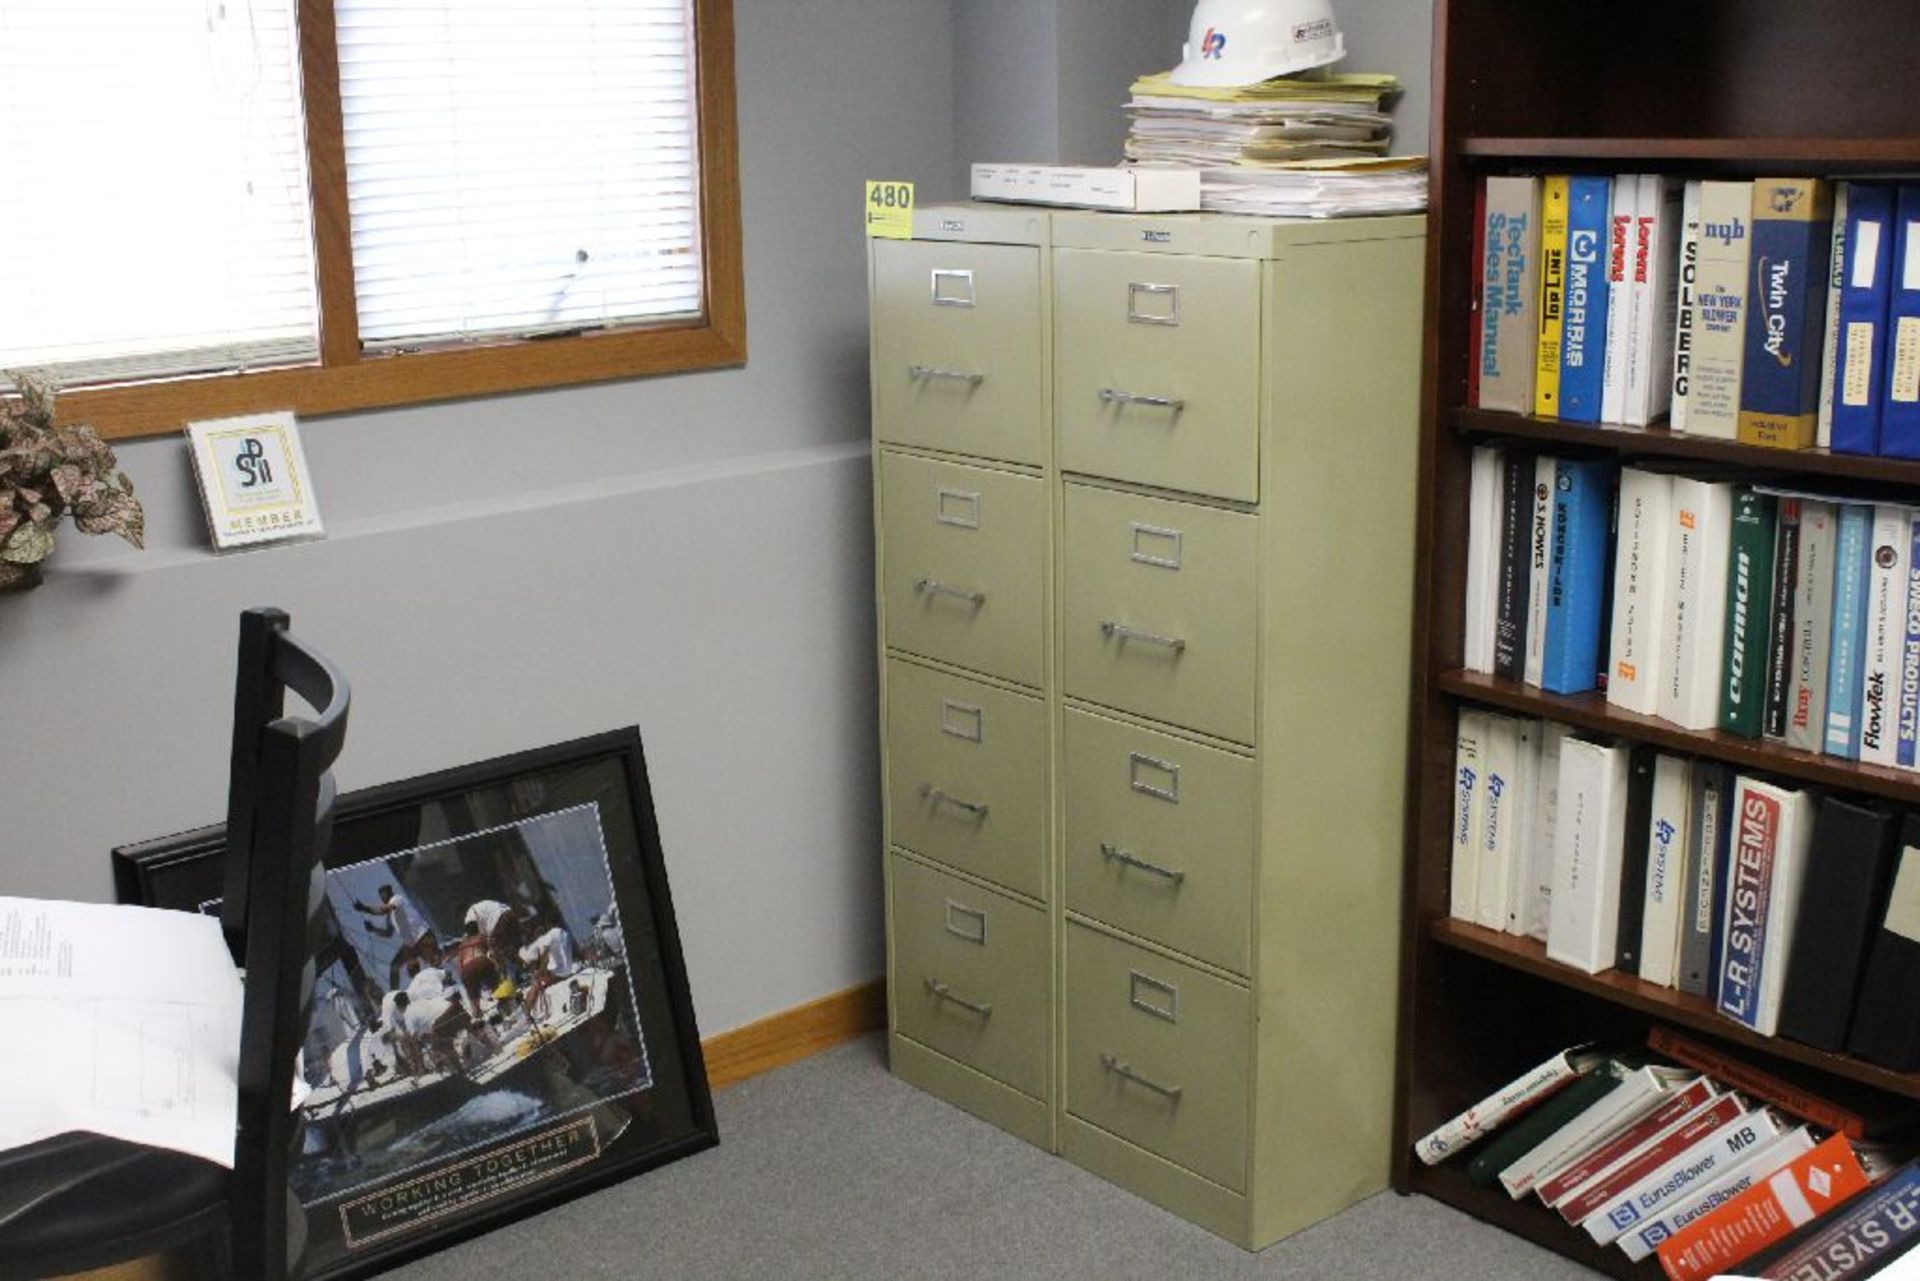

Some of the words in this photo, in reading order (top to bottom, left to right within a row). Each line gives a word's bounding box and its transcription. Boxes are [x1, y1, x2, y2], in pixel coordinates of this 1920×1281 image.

[870, 184, 910, 208] 480
[1486, 212, 1506, 281] Sales
[1505, 212, 1528, 315] TecTank
[1705, 218, 1745, 246] nyb
[1570, 264, 1588, 367] MORRIS
[1698, 293, 1718, 307] NEW
[1719, 295, 1742, 309] YORK
[1769, 260, 1790, 309] Twin
[1483, 284, 1504, 378] Manual
[1675, 242, 1698, 396] SOLBERG
[1764, 313, 1786, 356] City
[230, 509, 303, 530] MEMBER
[1907, 567, 1920, 634] SWECO
[1792, 684, 1811, 730] Bray
[1863, 671, 1885, 750] FlowTek
[1899, 641, 1920, 741] PRODUCTS
[1731, 801, 1767, 954] SYSTEMS
[1723, 962, 1747, 1017] L-R
[361, 1174, 462, 1217] WORKING
[473, 1129, 582, 1178] TOGETHER
[1639, 1154, 1716, 1209] EurusBlower
[1726, 1126, 1756, 1154] MB
[1673, 1174, 1753, 1229] EurusBlower
